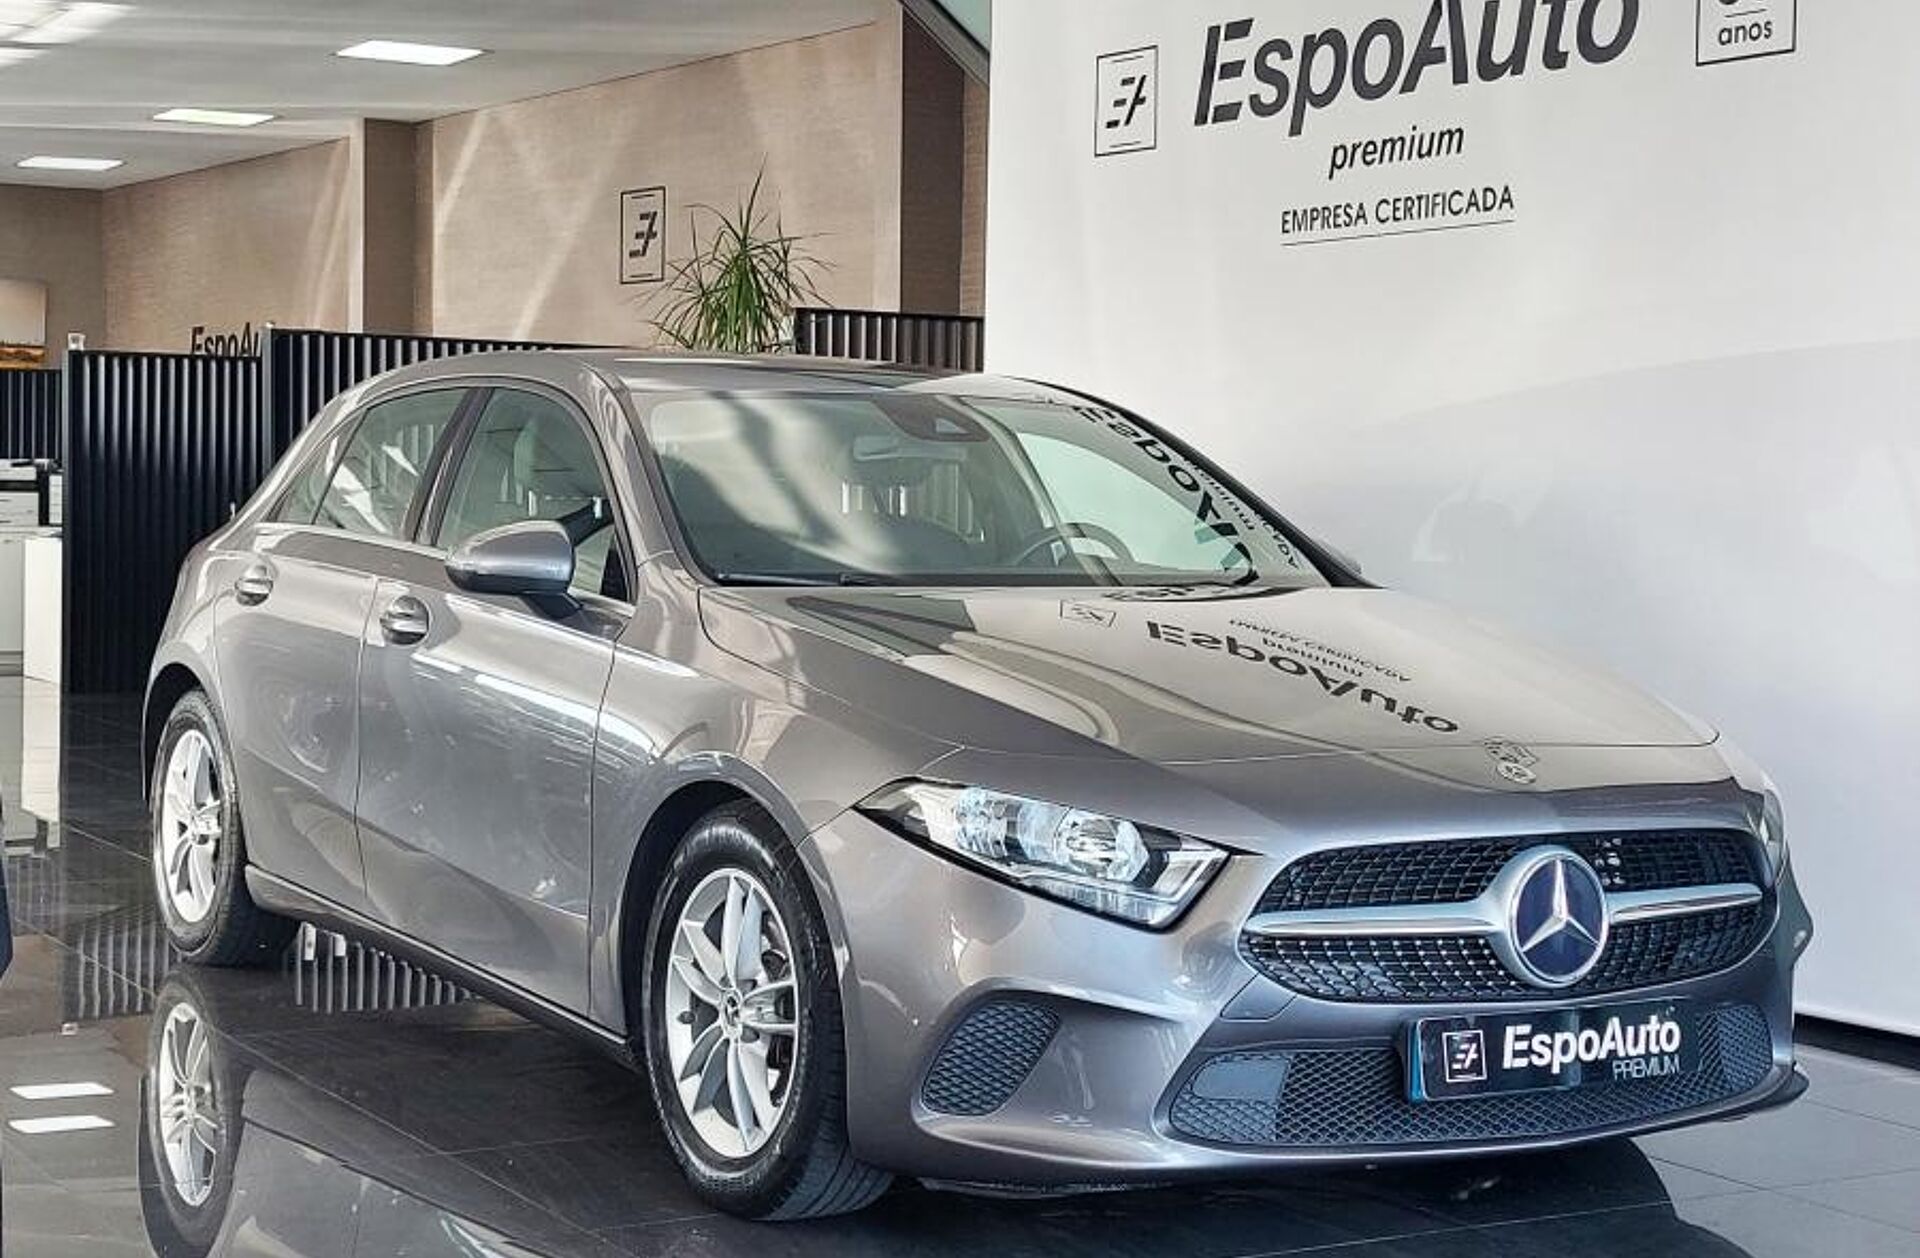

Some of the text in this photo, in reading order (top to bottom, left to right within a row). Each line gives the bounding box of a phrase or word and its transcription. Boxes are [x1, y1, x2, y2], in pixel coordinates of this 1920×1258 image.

[1718, 20, 1772, 46] anos
[1194, 0, 1640, 137] EspoAuto
[1328, 124, 1465, 181] premium
[1281, 184, 1514, 234] EMPRESA CERTIFICADA
[1502, 1015, 1681, 1075] EspoAuto
[1612, 1055, 1680, 1081] PREMIUM
